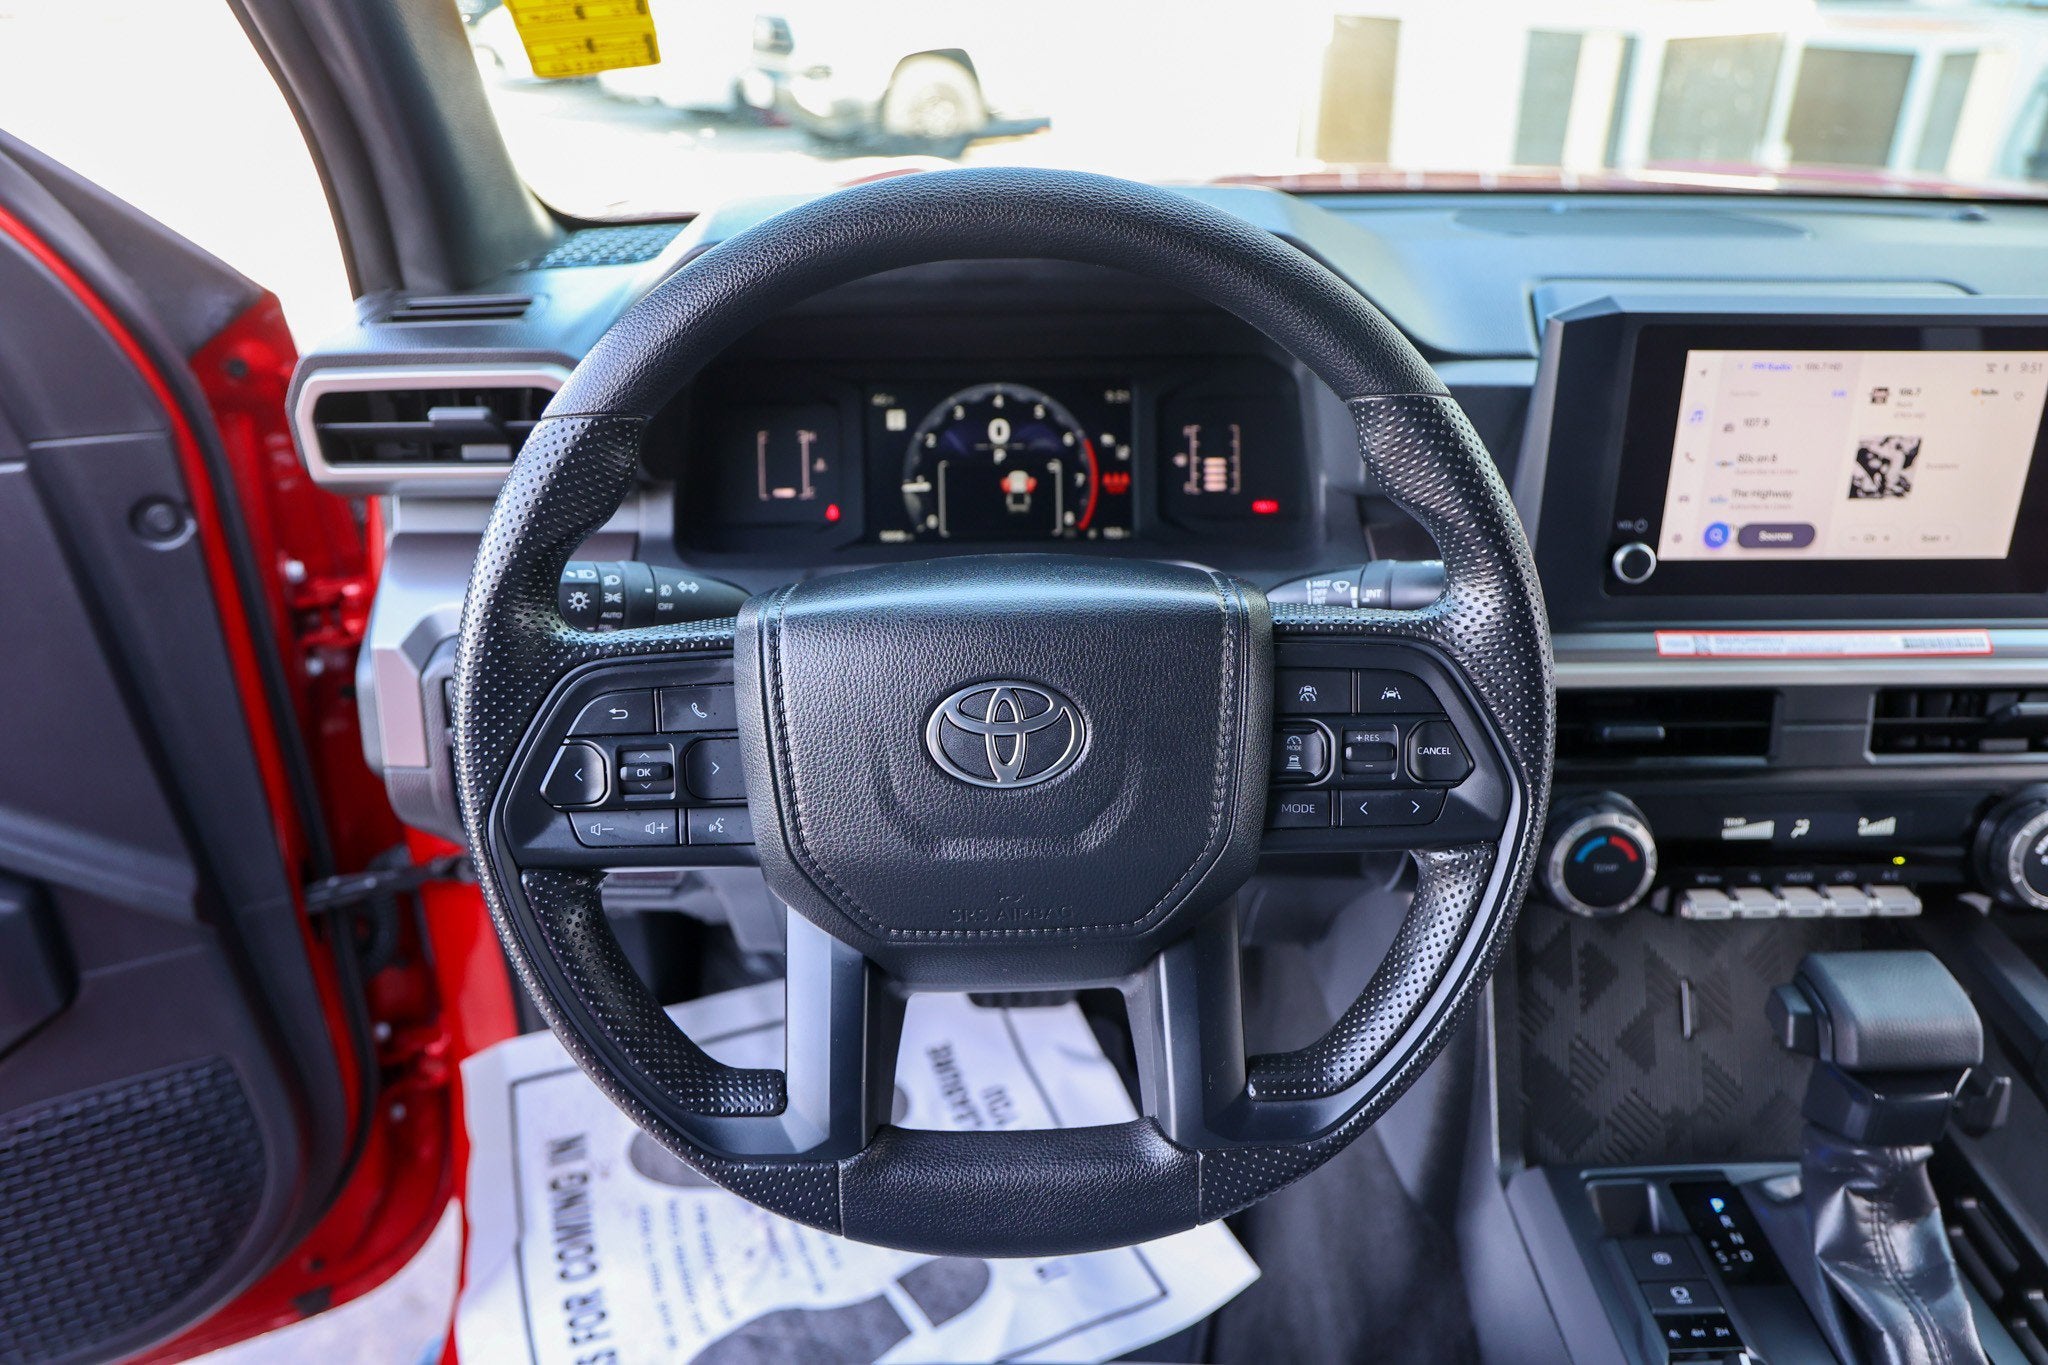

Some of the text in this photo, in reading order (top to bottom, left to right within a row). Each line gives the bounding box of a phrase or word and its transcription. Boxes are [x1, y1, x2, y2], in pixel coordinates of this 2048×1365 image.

[988, 418, 1011, 445] 0
[1365, 589, 1382, 598] INT
[658, 602, 674, 611] OFF
[601, 611, 623, 619] AUTO
[1417, 746, 1451, 755] CANCEL
[636, 768, 651, 777] OK
[1281, 803, 1316, 813] MODE
[997, 905, 1074, 921] AIRBAG
[548, 1132, 587, 1167] IN
[550, 1171, 597, 1283] COMING
[1740, 1251, 1753, 1262] D
[564, 1286, 612, 1346] FOR
